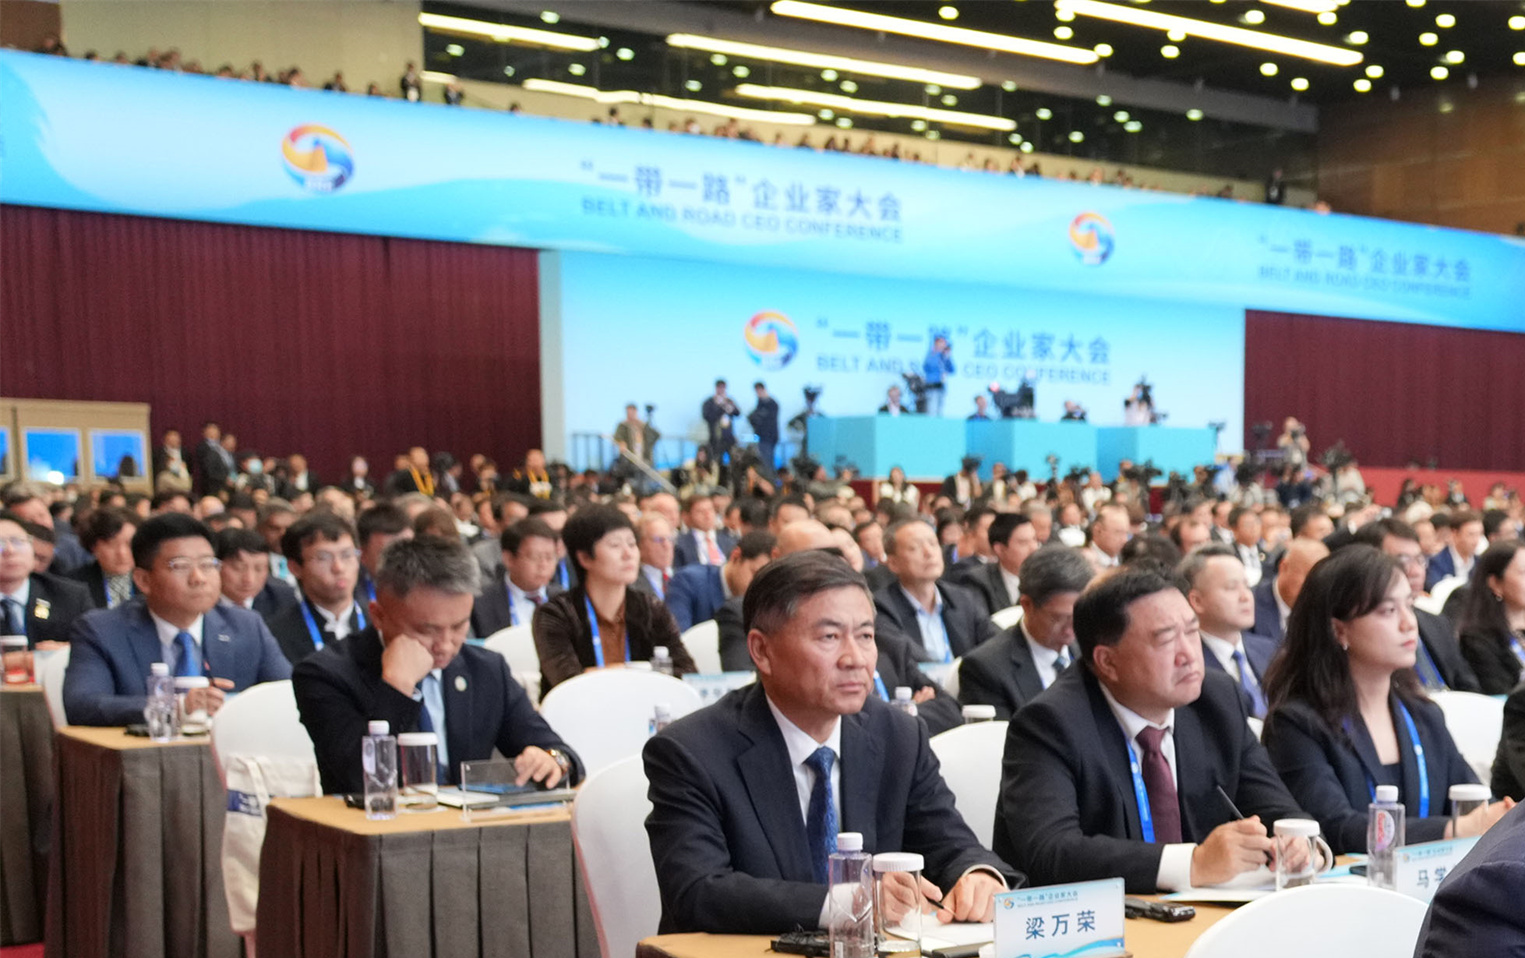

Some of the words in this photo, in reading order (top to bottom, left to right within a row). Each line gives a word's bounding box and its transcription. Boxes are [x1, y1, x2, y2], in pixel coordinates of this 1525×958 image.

[582, 198, 628, 217] BELT
[637, 202, 677, 222] AND
[683, 206, 736, 228] ROAD
[741, 213, 780, 231] CEO
[786, 217, 903, 243] CONFERENCE
[817, 355, 859, 371] BELT
[867, 358, 902, 374] AND
[964, 362, 997, 379] CEO
[1004, 366, 1111, 386] COFERENCE
[1025, 909, 1096, 941] 梁万荣
